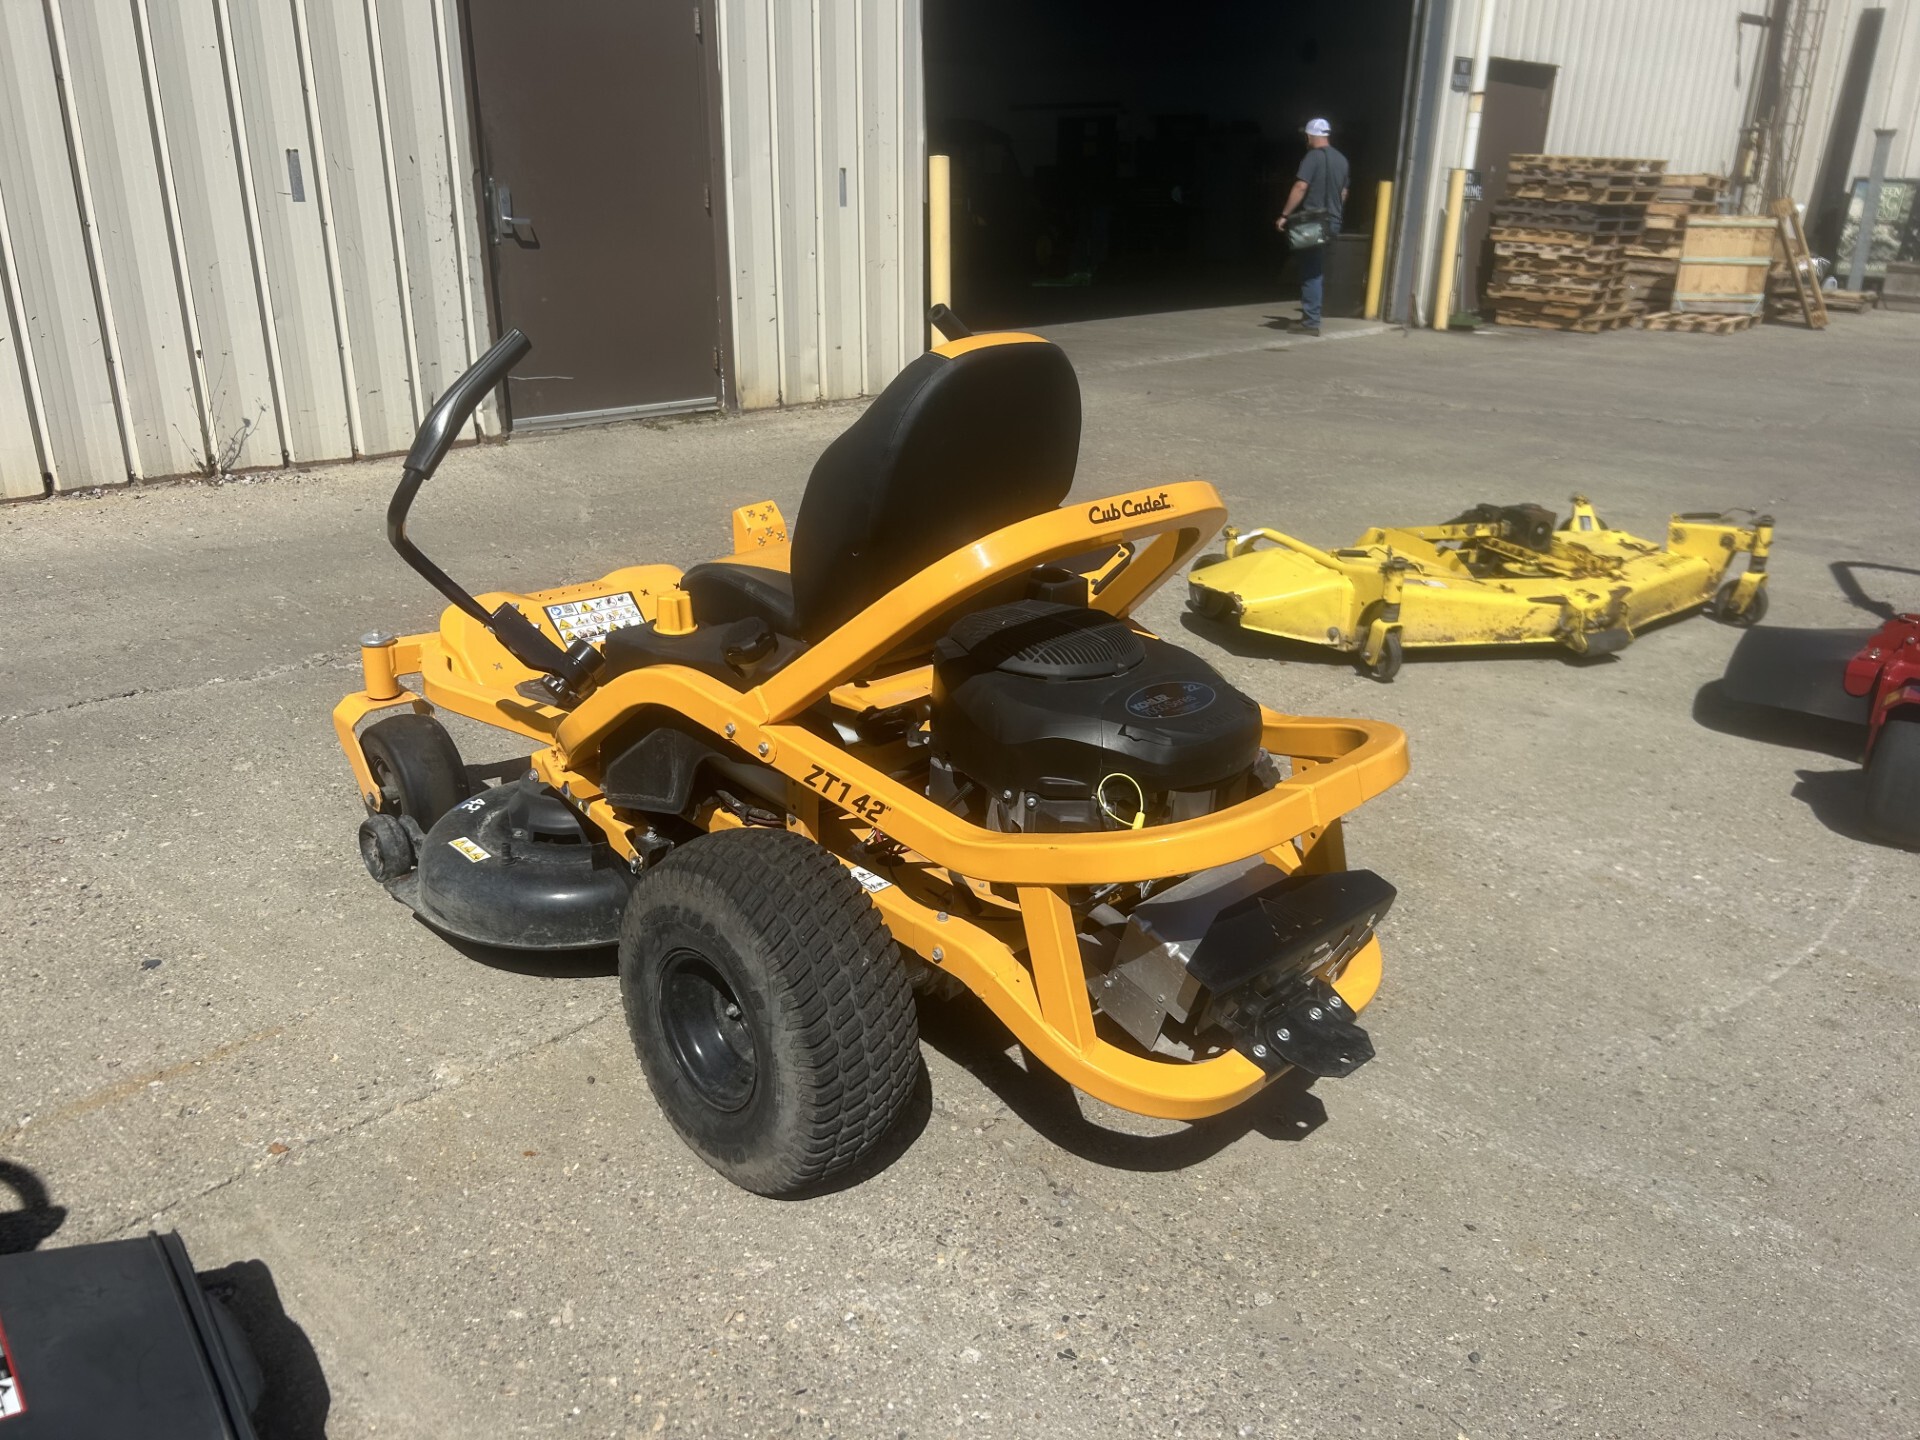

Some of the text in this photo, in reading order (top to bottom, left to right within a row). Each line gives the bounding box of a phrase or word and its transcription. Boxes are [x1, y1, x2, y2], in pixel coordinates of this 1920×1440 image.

[1088, 492, 1171, 524] Cub Cadet
[803, 763, 852, 803] ZT1
